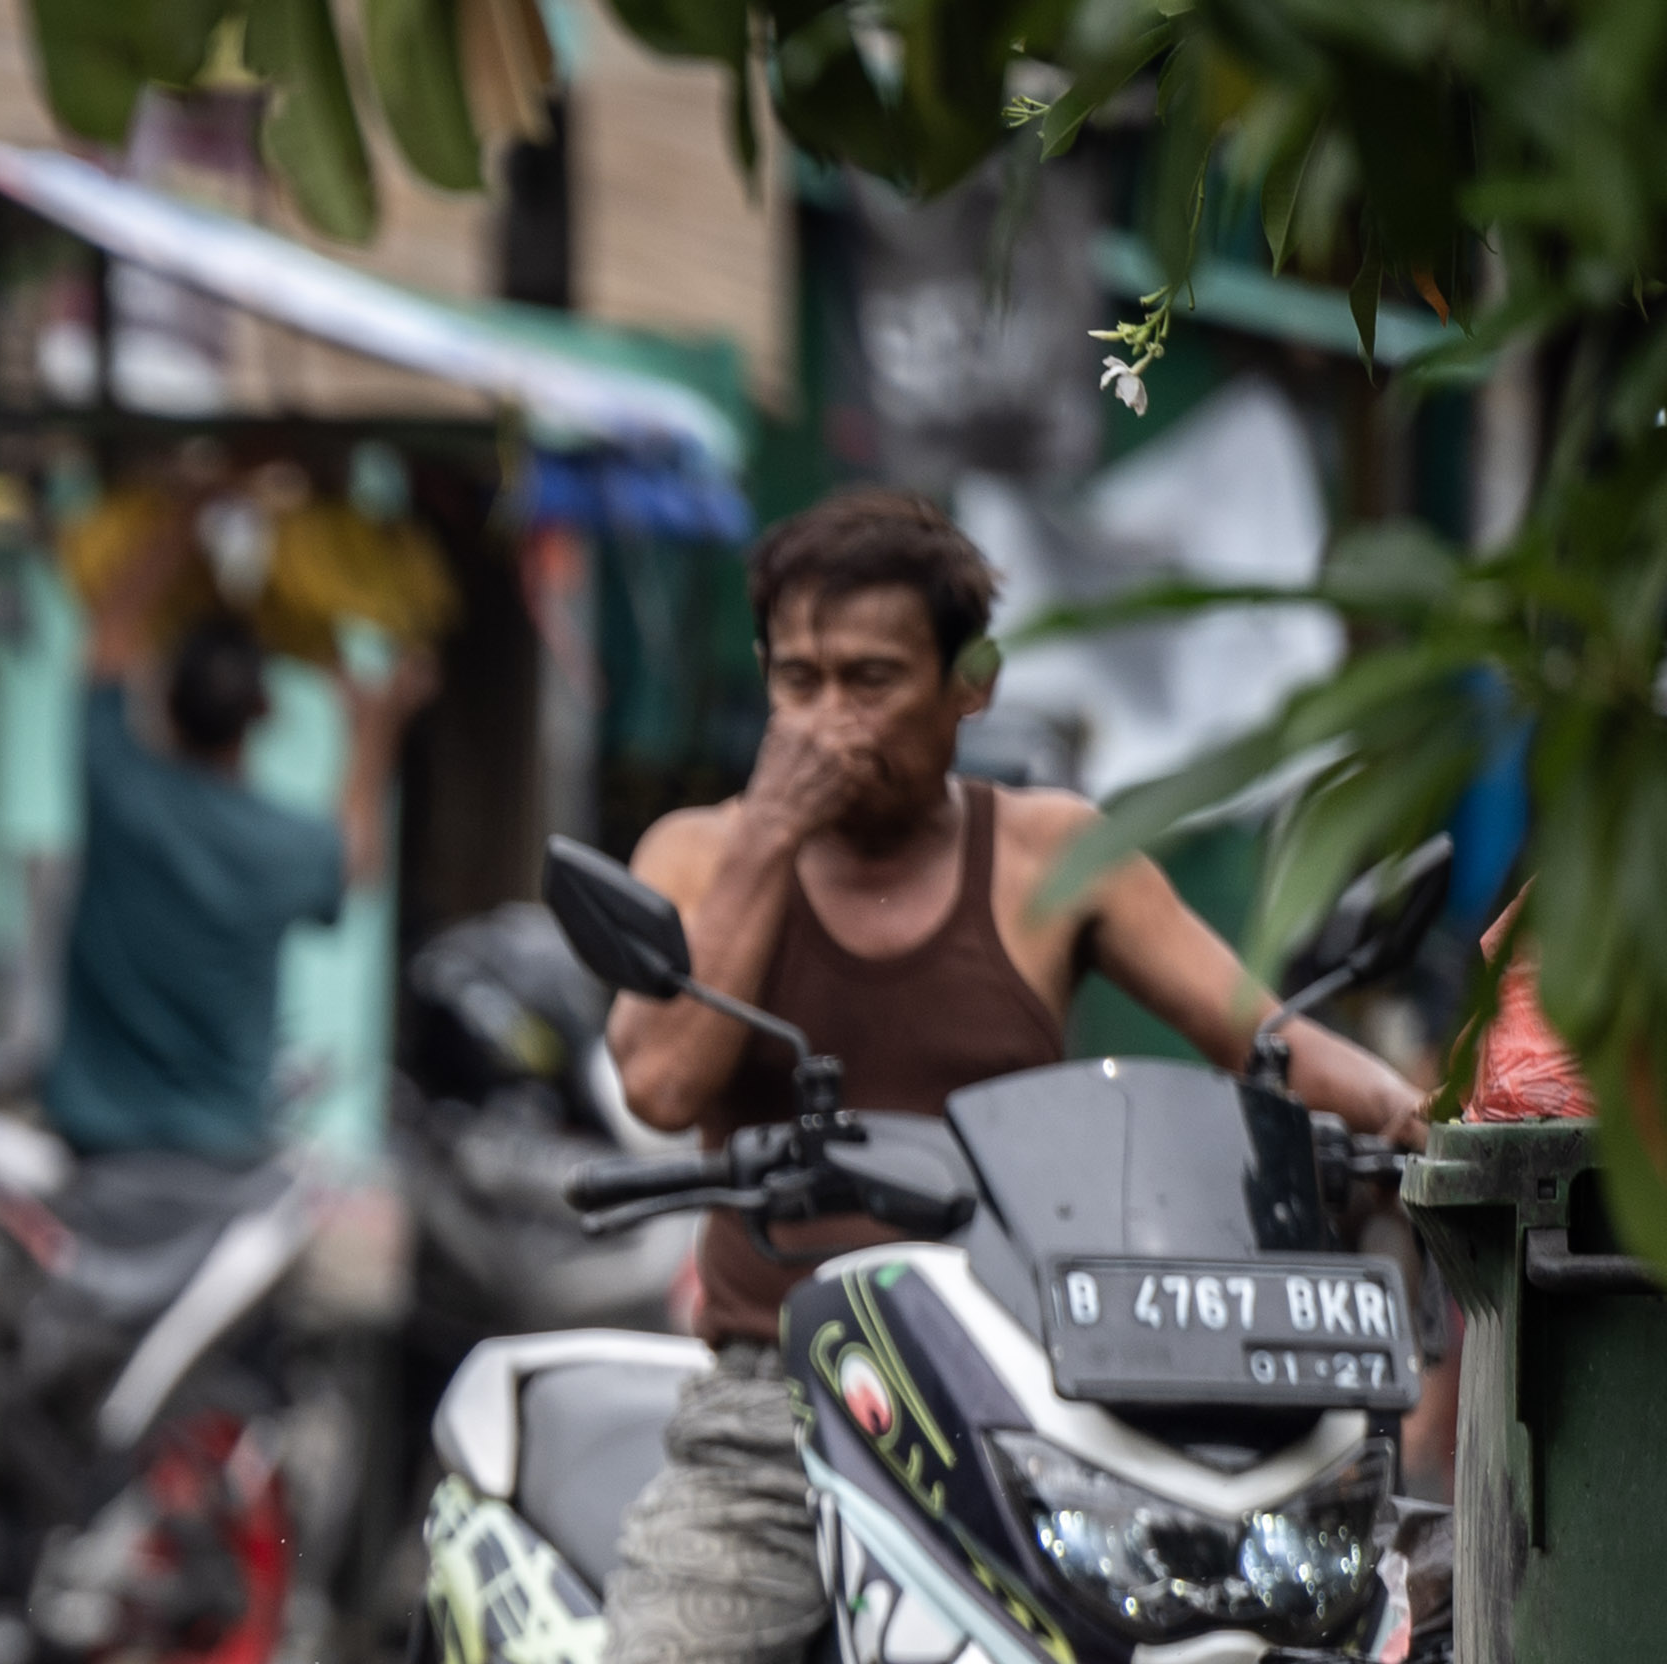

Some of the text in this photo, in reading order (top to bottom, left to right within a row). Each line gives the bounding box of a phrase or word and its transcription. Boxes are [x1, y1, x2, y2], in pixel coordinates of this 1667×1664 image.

[1066, 1271, 1388, 1338] B 4767 BKR
